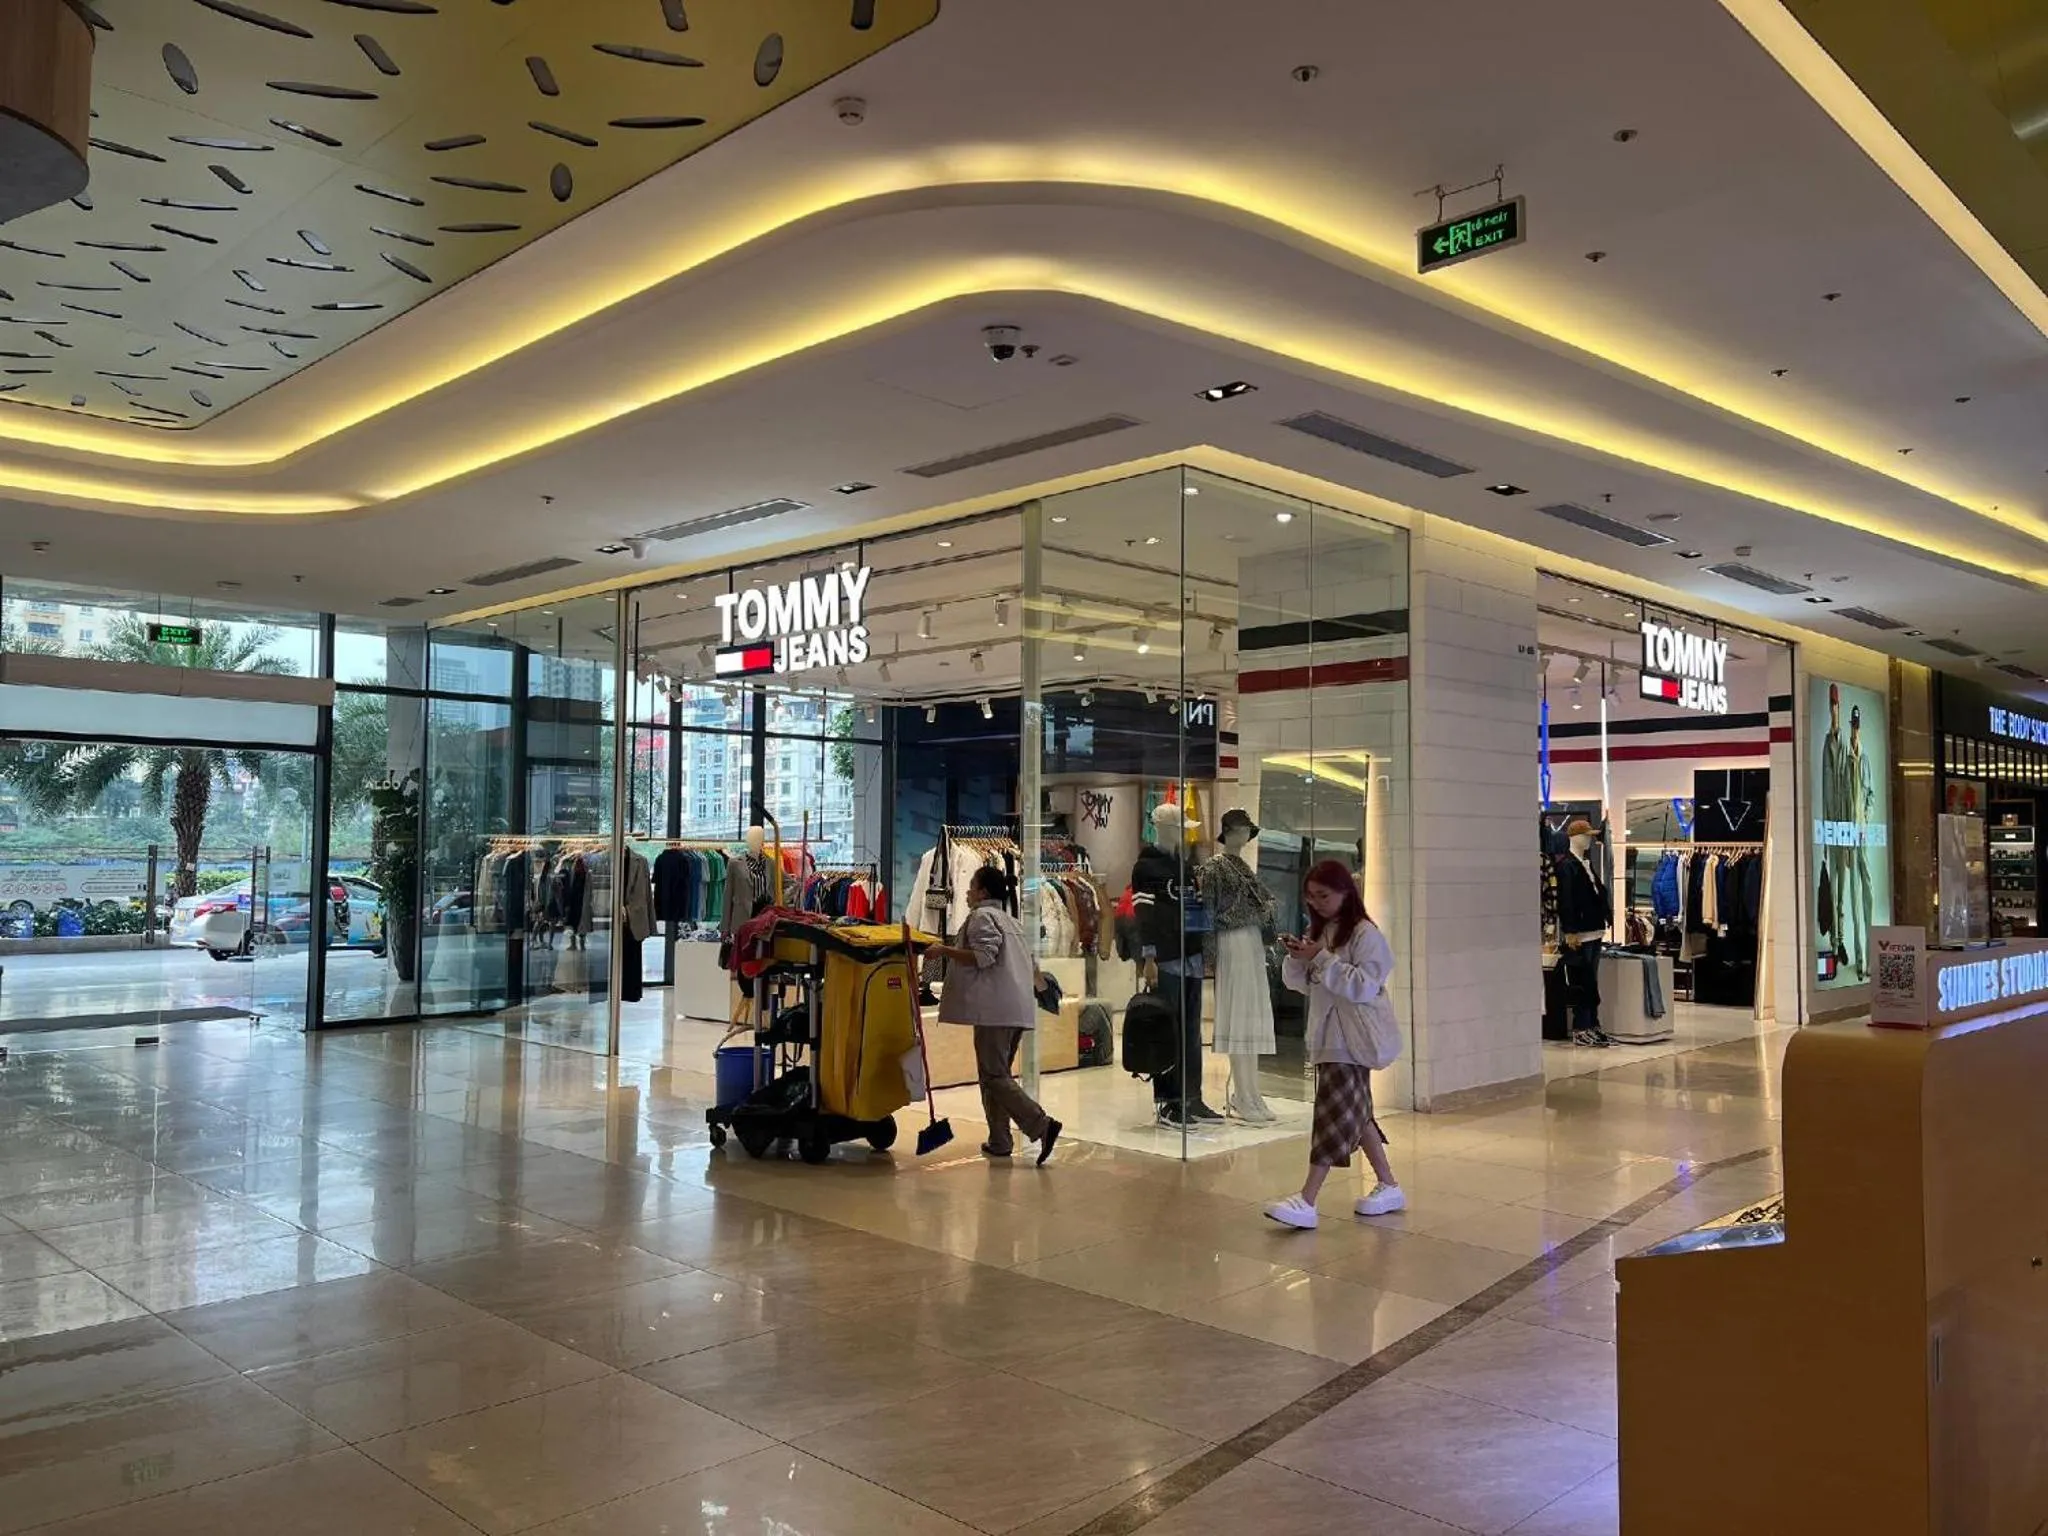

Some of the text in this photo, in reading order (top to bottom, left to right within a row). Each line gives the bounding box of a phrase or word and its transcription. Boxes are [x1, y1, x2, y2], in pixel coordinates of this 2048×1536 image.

[1475, 229, 1505, 247] EXIT
[715, 566, 872, 643] TOMMY
[161, 625, 189, 636] EXIT
[773, 626, 870, 674] JEANS
[1641, 621, 1728, 684] TOMMY
[1678, 678, 1728, 715] JEANS
[1989, 706, 2007, 736] THE
[2008, 711, 2031, 740] BODY
[365, 780, 401, 791] ALDO
[1938, 959, 1999, 1012] SUNNIES
